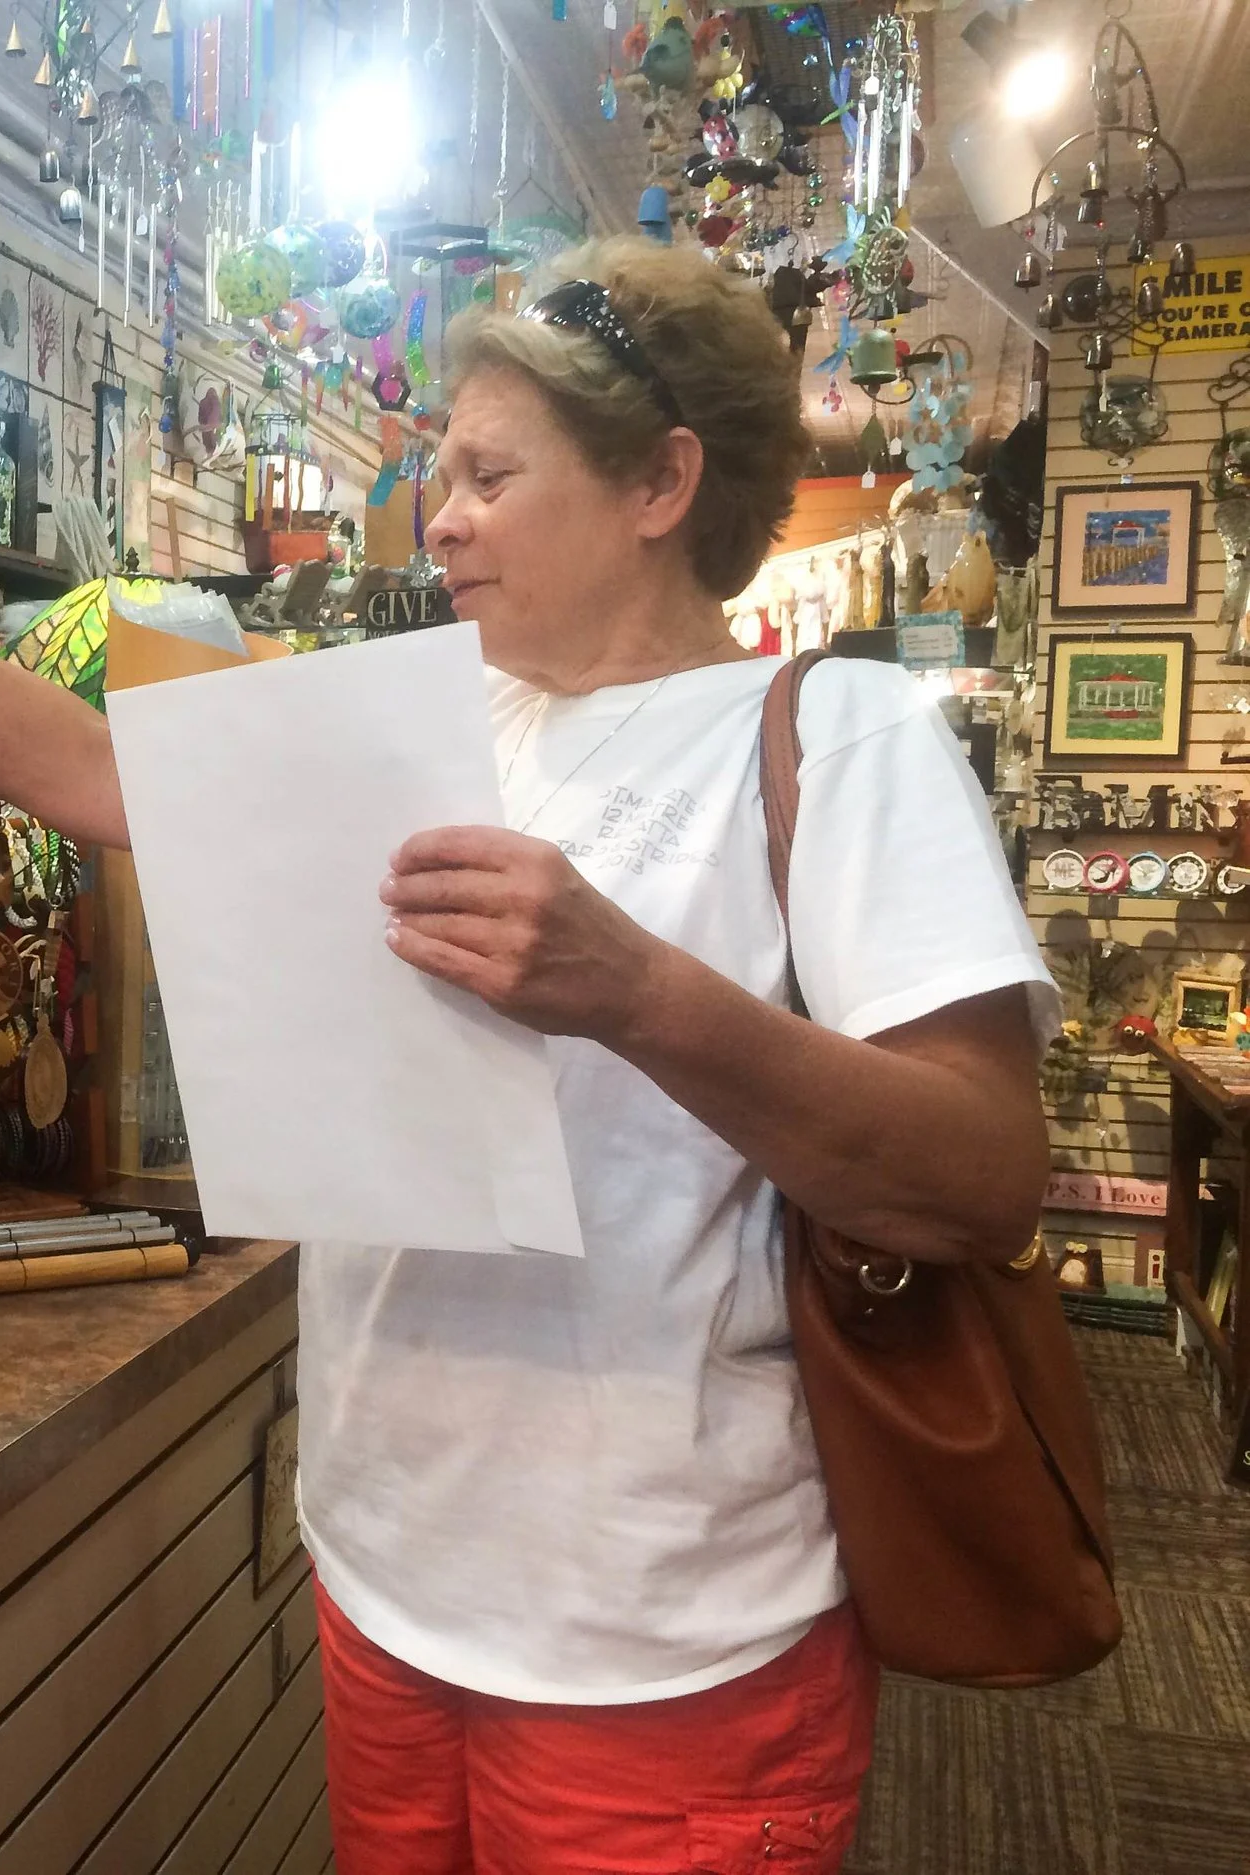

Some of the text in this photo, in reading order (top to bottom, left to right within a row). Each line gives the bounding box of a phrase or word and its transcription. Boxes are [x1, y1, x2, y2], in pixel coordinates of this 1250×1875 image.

[1161, 304, 1229, 322] OU'RE
[367, 588, 438, 627] GIVE
[1047, 1182, 1087, 1200] P.S.
[1110, 1186, 1161, 1206] Love
